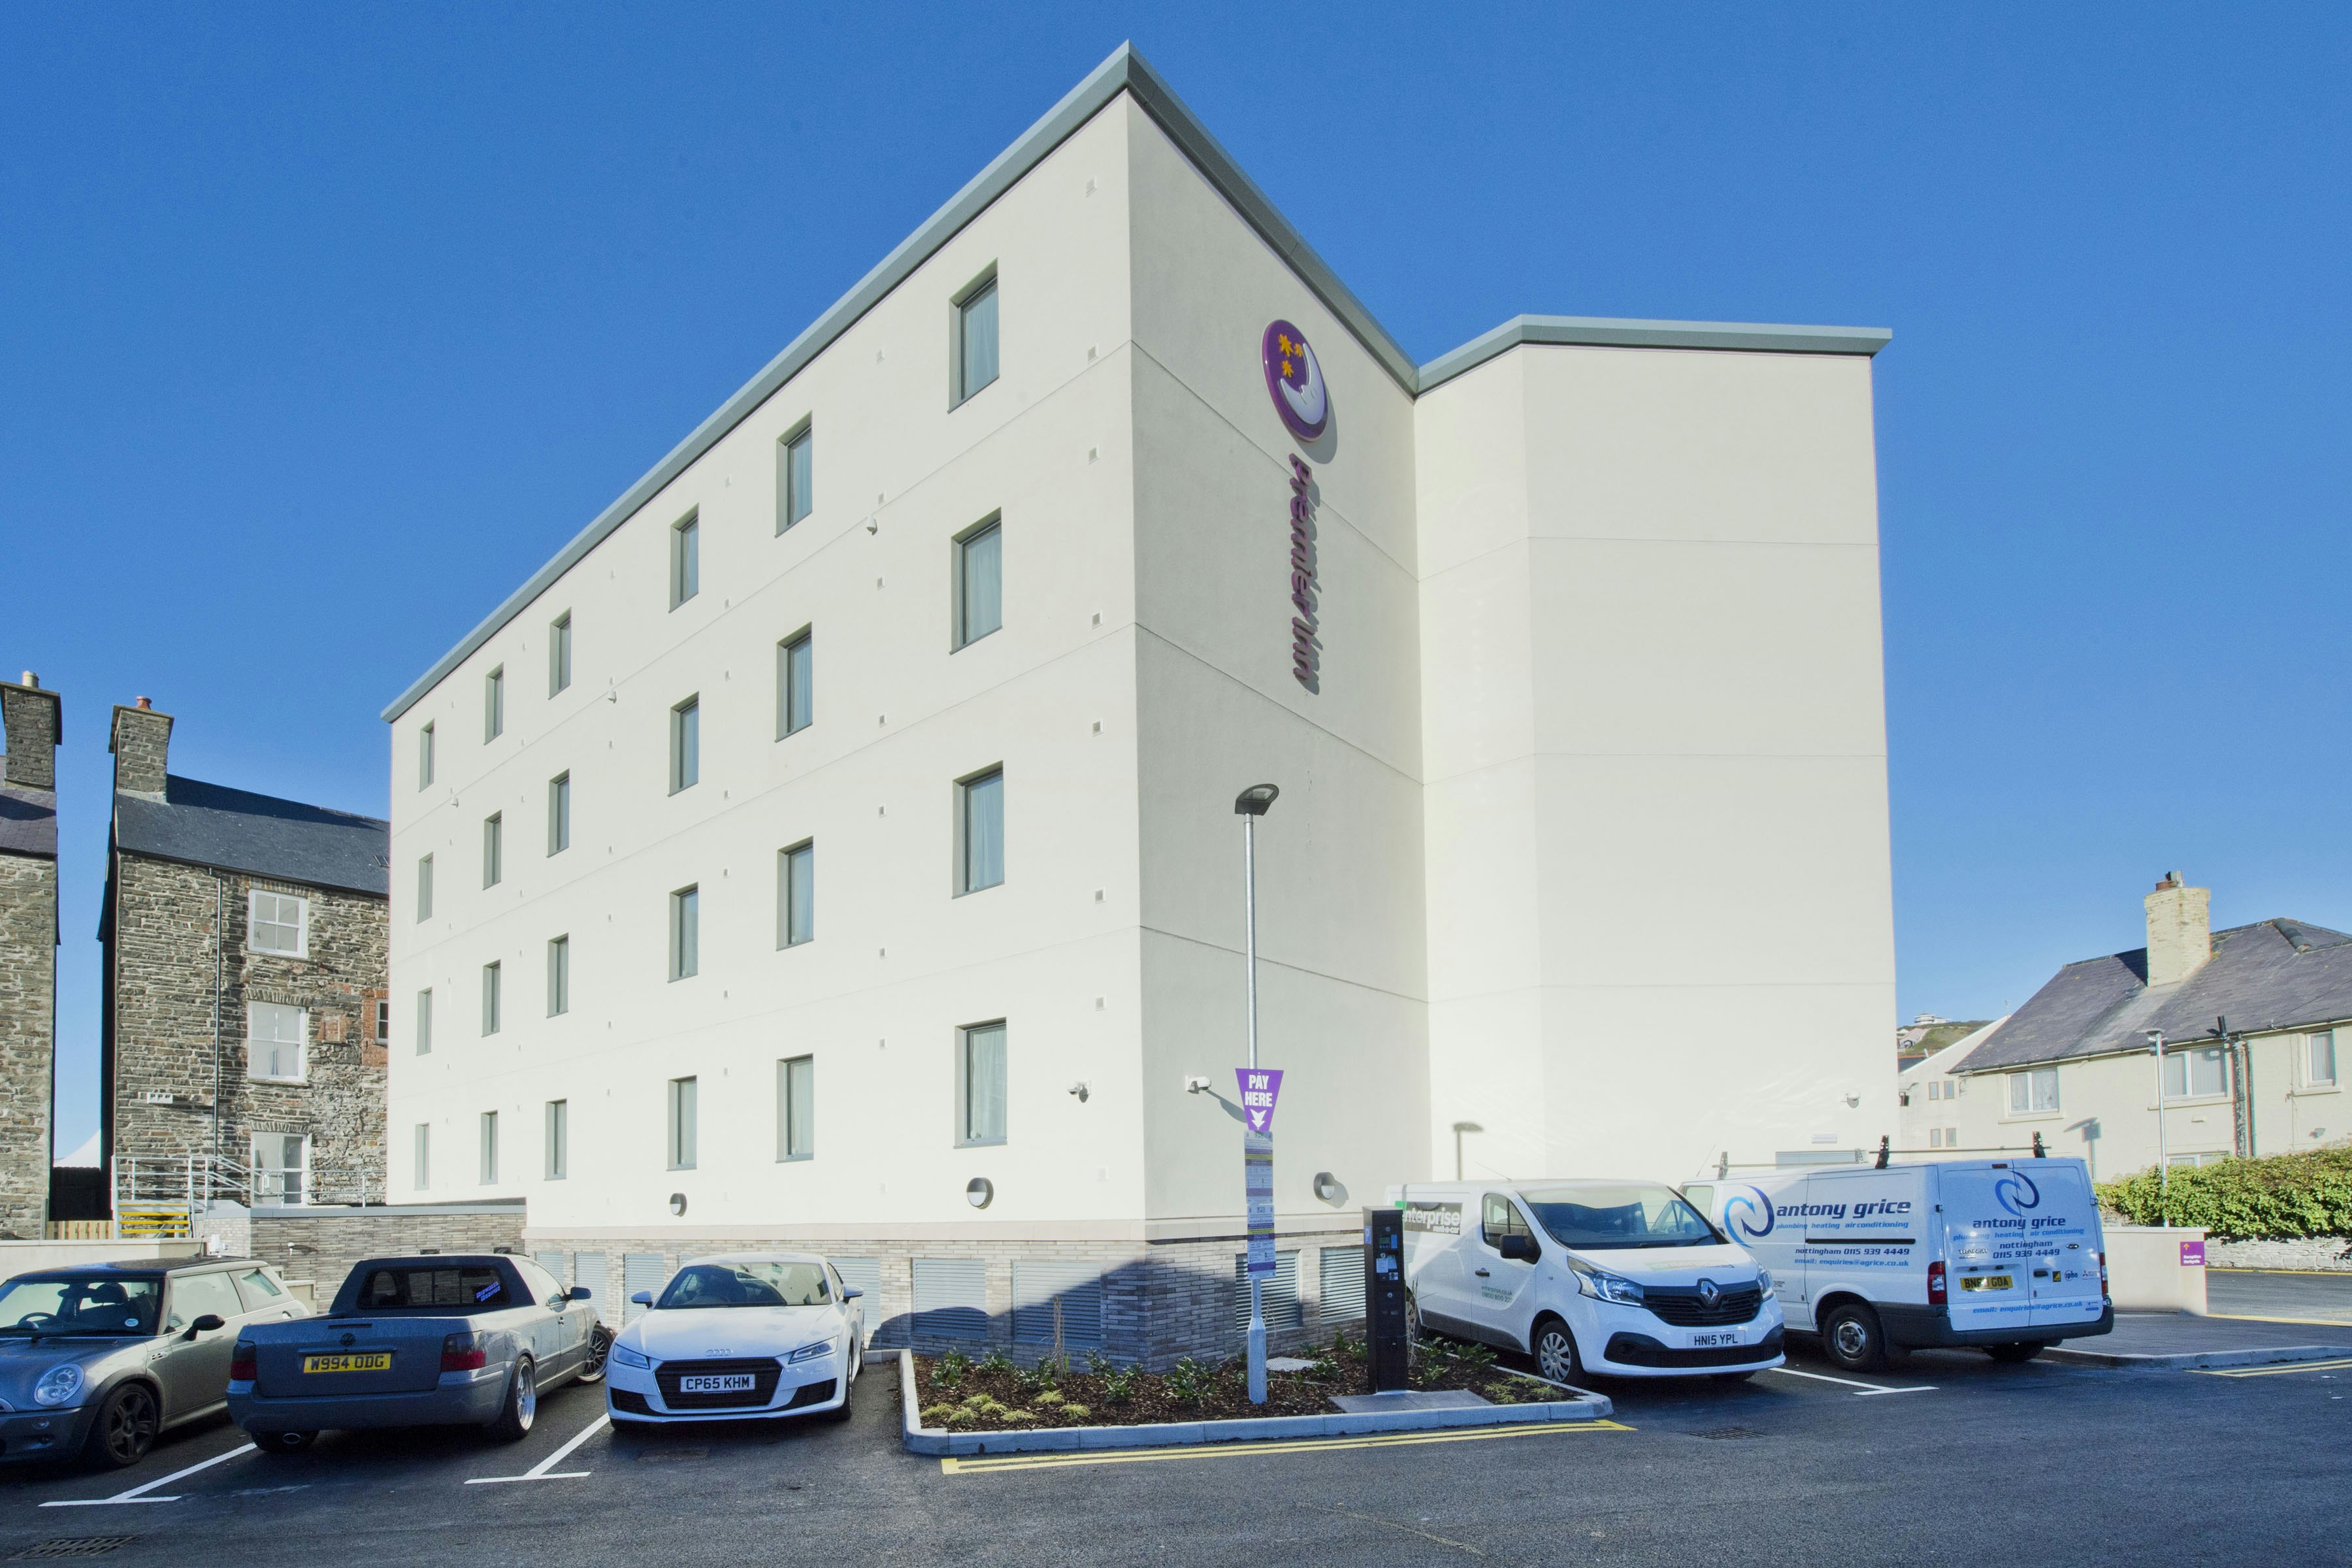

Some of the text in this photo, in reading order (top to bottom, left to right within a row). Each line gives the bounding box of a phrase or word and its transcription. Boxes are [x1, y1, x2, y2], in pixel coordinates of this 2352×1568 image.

[1289, 452, 1316, 681] Premier Inn
[1249, 1074, 1269, 1090] PAY
[1245, 1091, 1273, 1107] HERE
[1776, 1198, 1912, 1219] antony grice
[1811, 1221, 1840, 1230] heating
[1972, 1216, 2066, 1230] antony grice
[2042, 1228, 2085, 1236] conditioning
[1795, 1247, 1842, 1256] nottingham
[1999, 1241, 2053, 1250] nottingham
[1993, 1250, 2012, 1259] 0115
[2035, 1249, 2061, 1257] 4449
[1819, 1258, 1910, 1267] enquiries@agrice.co.uk
[1972, 1306, 1997, 1315] email:
[1999, 1301, 2083, 1313] enquiries@agrice.co.uk
[1694, 1333, 1738, 1346] HN15 YPL
[310, 1357, 349, 1370] W994
[686, 1377, 749, 1390] CP65 KHM
